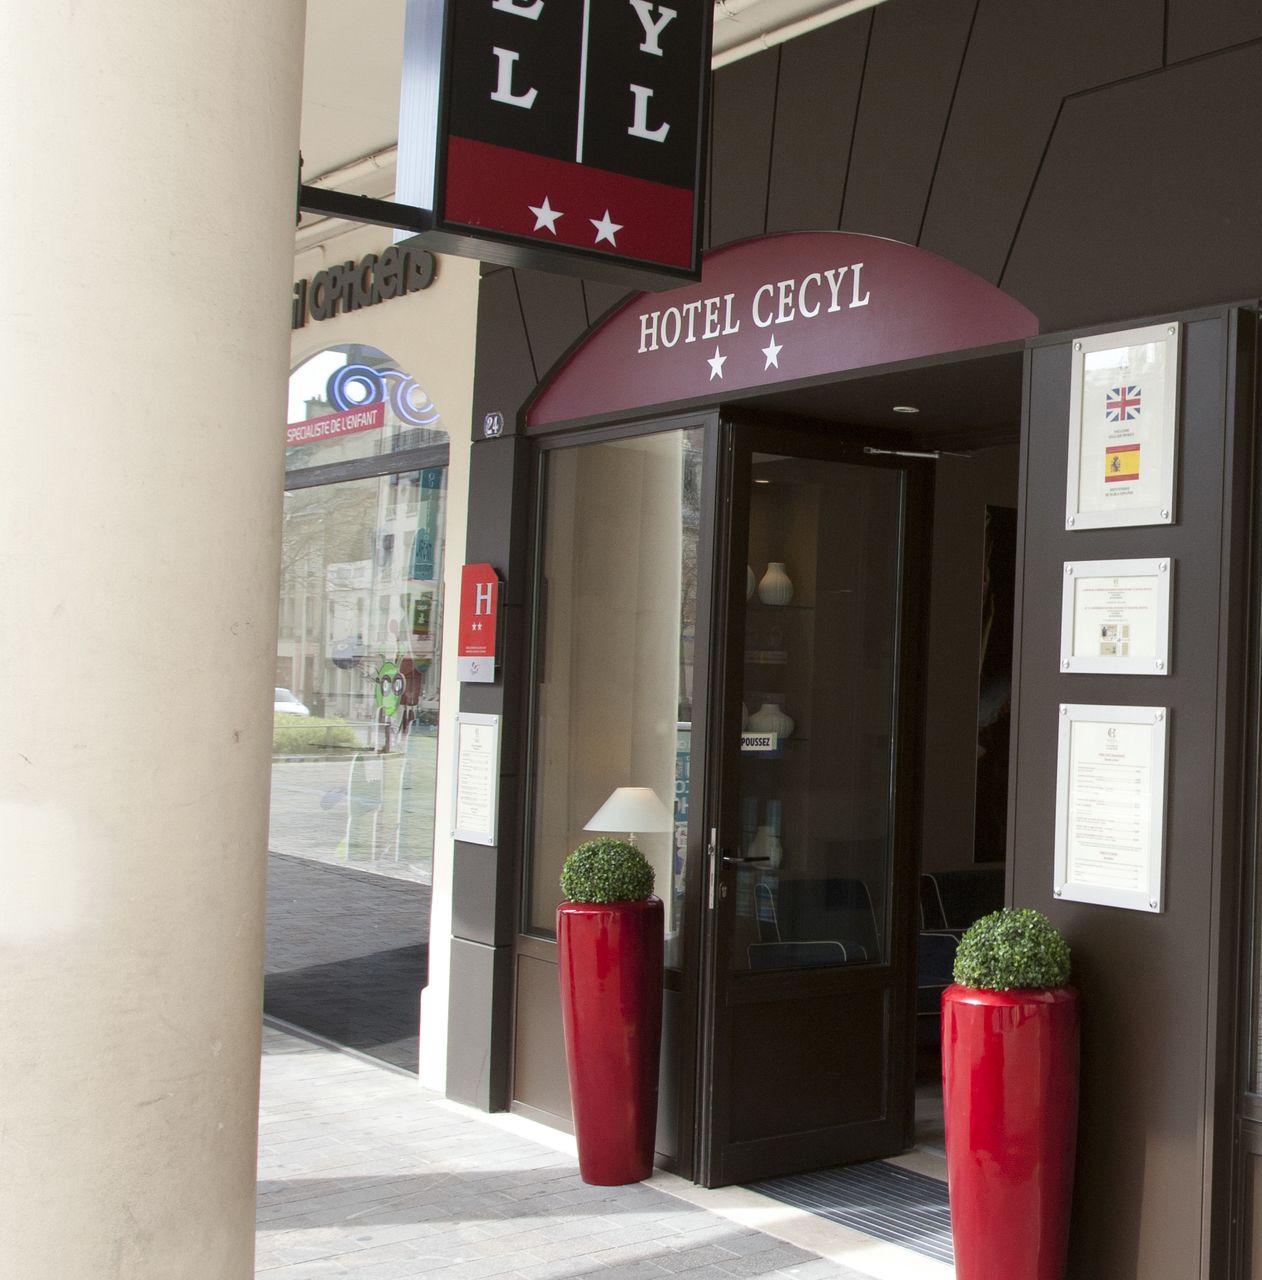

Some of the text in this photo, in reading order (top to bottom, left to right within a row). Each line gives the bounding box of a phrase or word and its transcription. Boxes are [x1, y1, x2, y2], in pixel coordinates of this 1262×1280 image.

[637, 262, 871, 354] HOTEL CECYL
[330, 418, 341, 434] DE
[342, 410, 378, 431] L'ENFANT
[487, 416, 499, 435] 24
[474, 582, 494, 616] H
[741, 737, 770, 747] POUSSEZ
